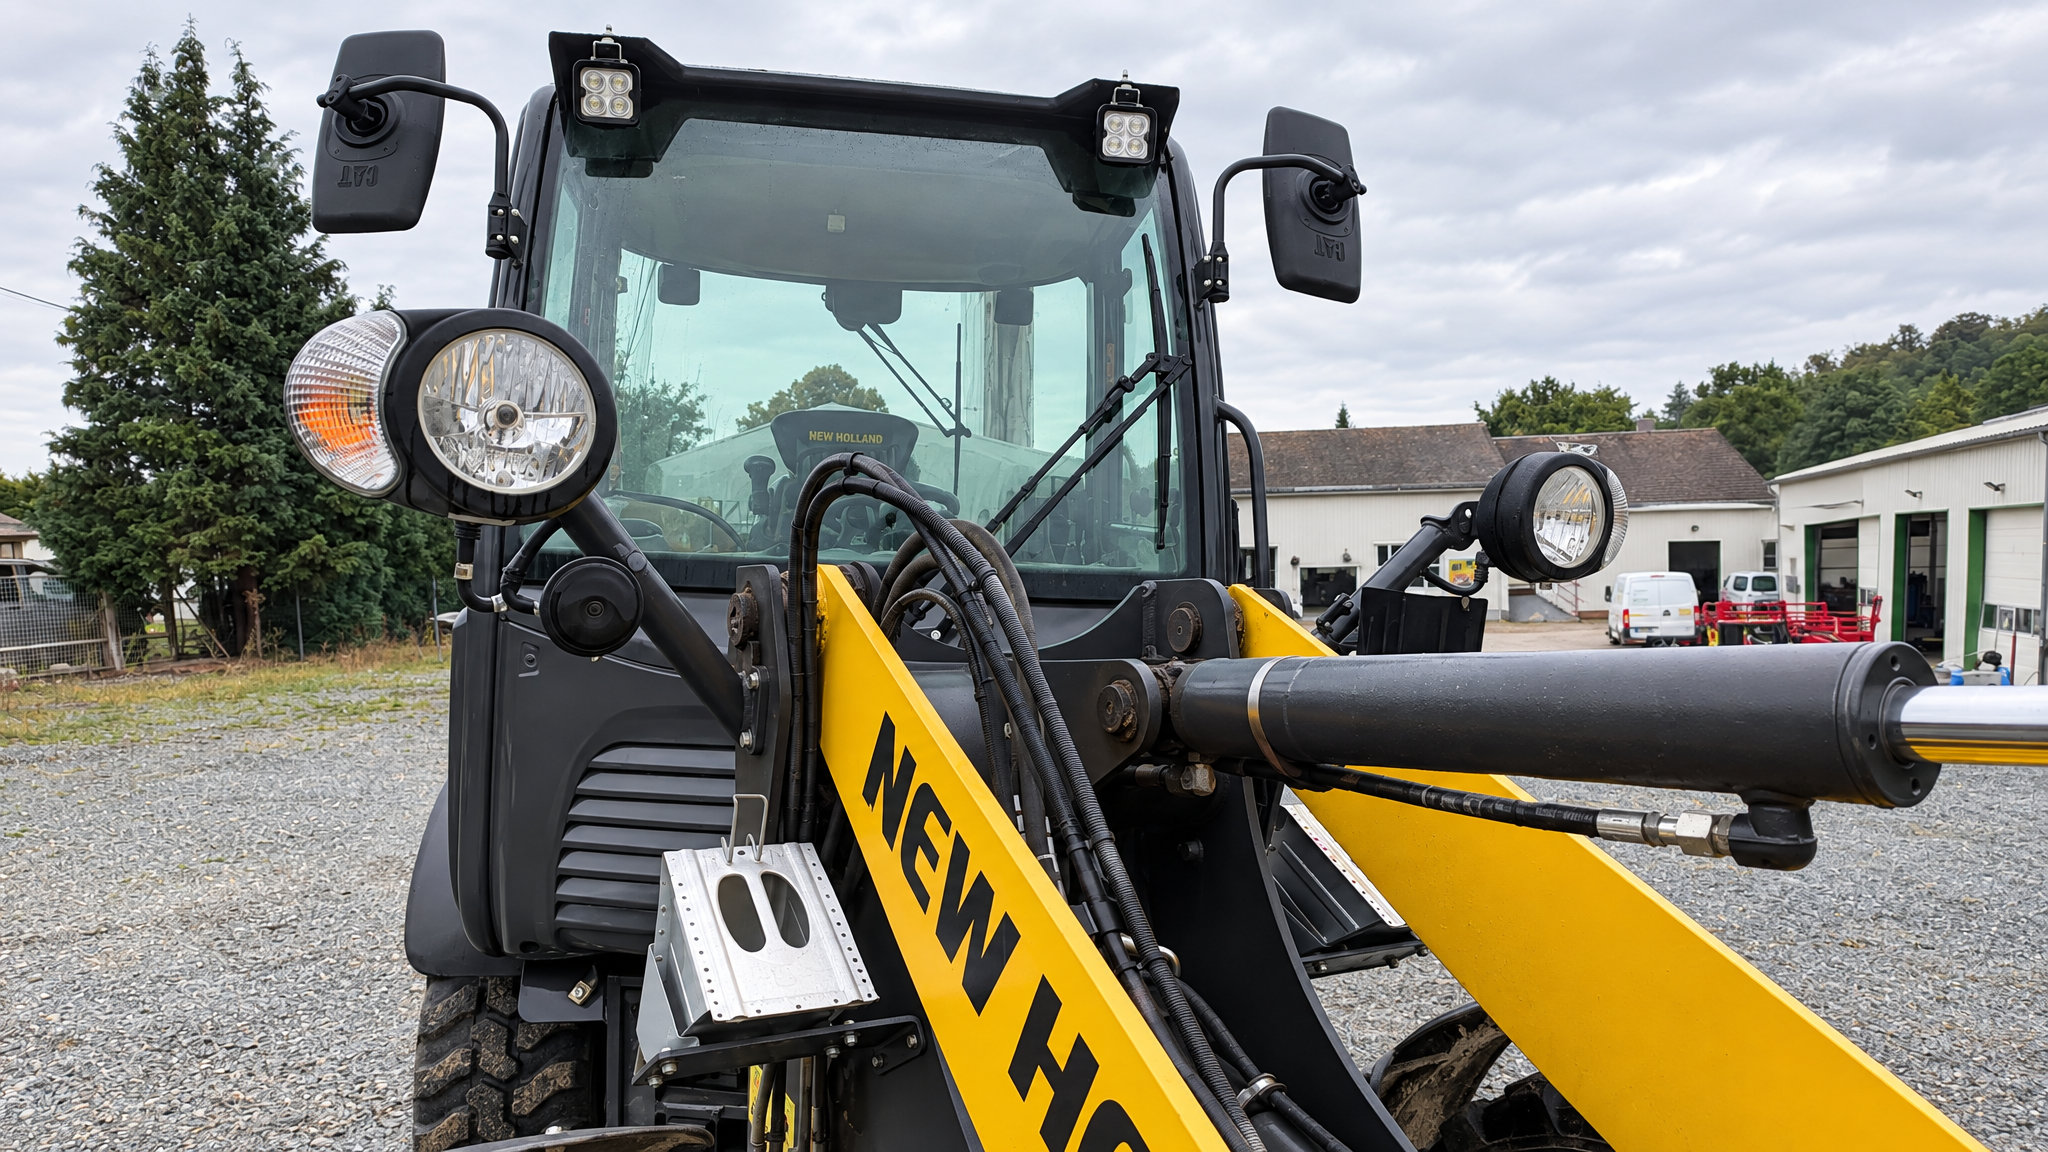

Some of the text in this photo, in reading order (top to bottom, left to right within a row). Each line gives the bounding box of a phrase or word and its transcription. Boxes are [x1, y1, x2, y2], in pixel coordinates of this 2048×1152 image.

[337, 165, 378, 187] CAT
[1314, 235, 1345, 262] CAT
[809, 431, 882, 444] NEW HOLLAND
[862, 710, 1022, 1017] NEW
